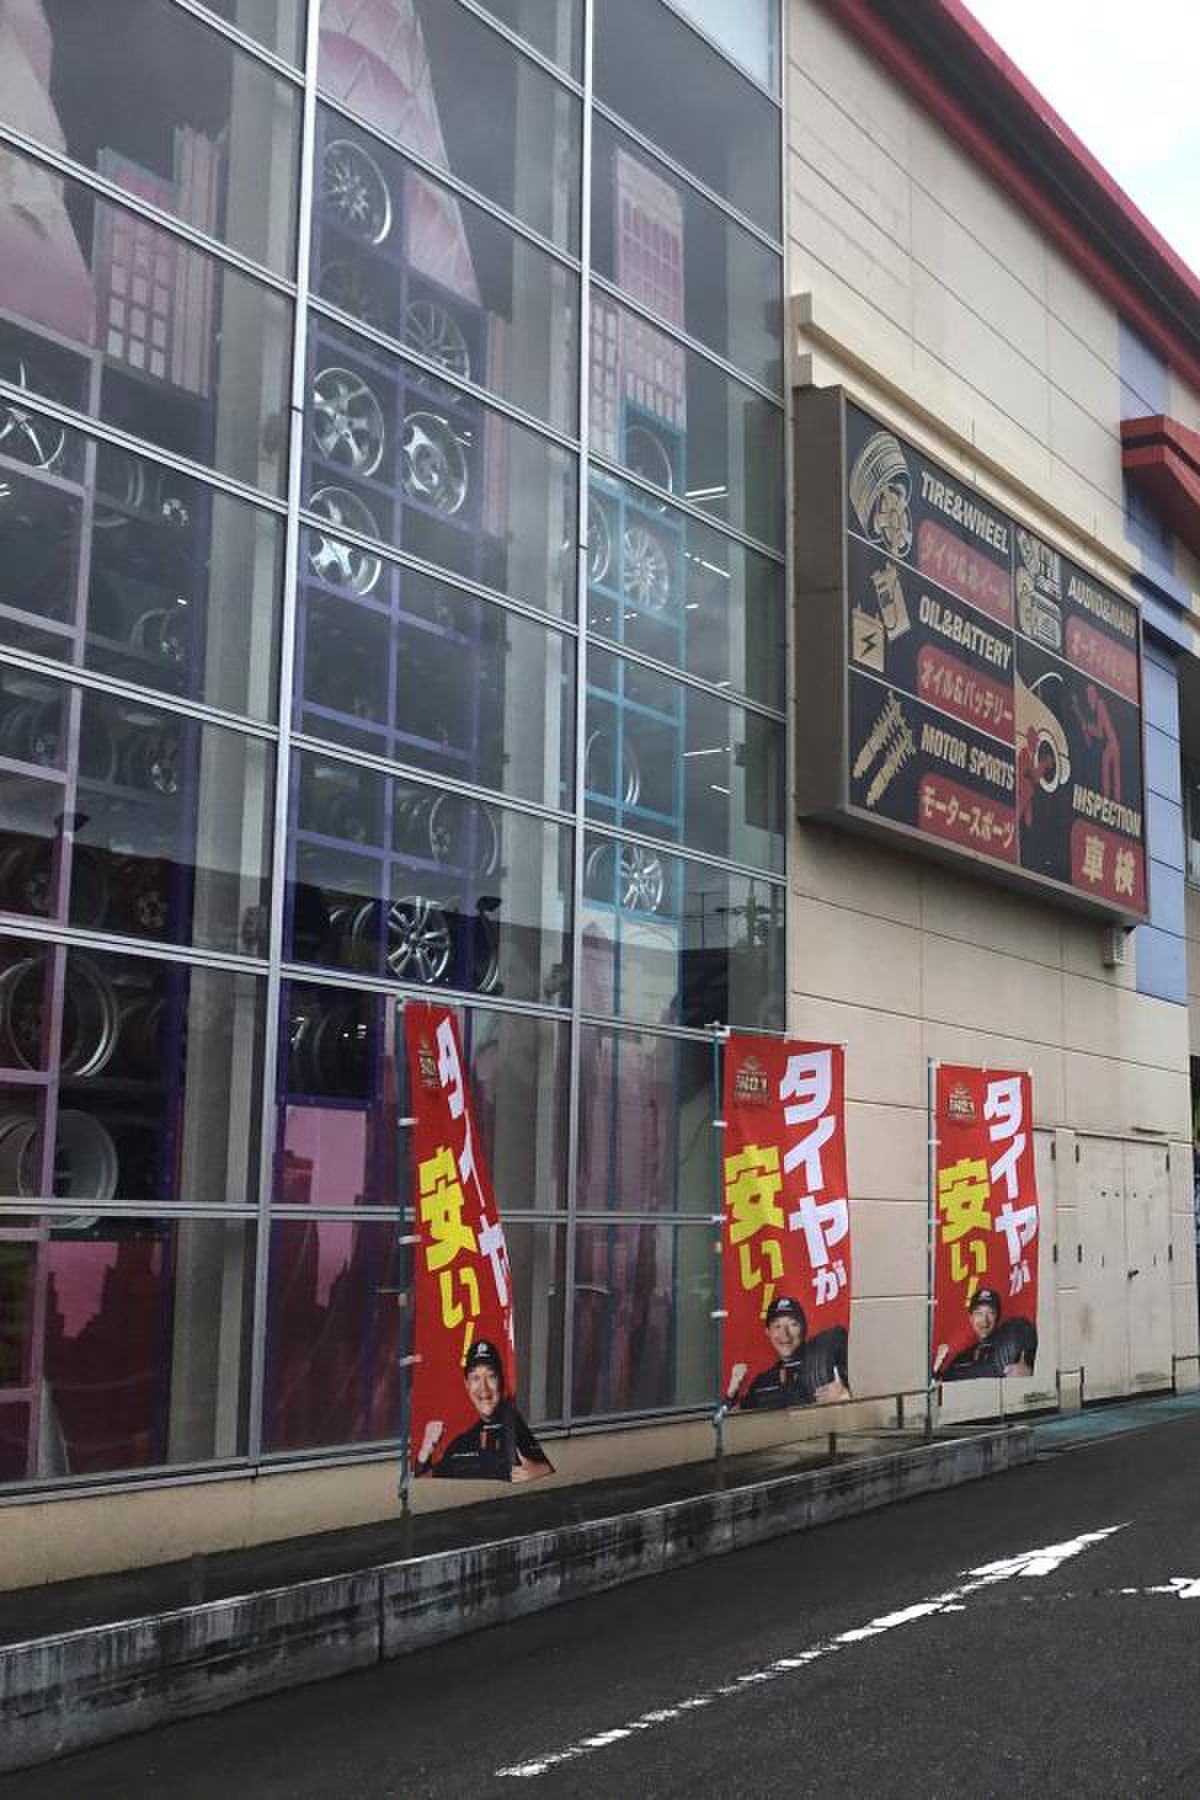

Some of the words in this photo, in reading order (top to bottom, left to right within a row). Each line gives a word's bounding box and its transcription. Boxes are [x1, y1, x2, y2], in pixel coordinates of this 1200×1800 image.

[921, 470, 1009, 555] TIRE&WHEEL
[919, 594, 1012, 671] OIL&BATTERY
[921, 723, 967, 769] MOTOR
[969, 746, 1015, 790] SPORTS
[923, 785, 1015, 849] モータースポーツ
[1072, 783, 1142, 838] INSPECTION
[779, 1048, 850, 1306] タイヤが
[983, 1077, 1039, 1297] タイヤが
